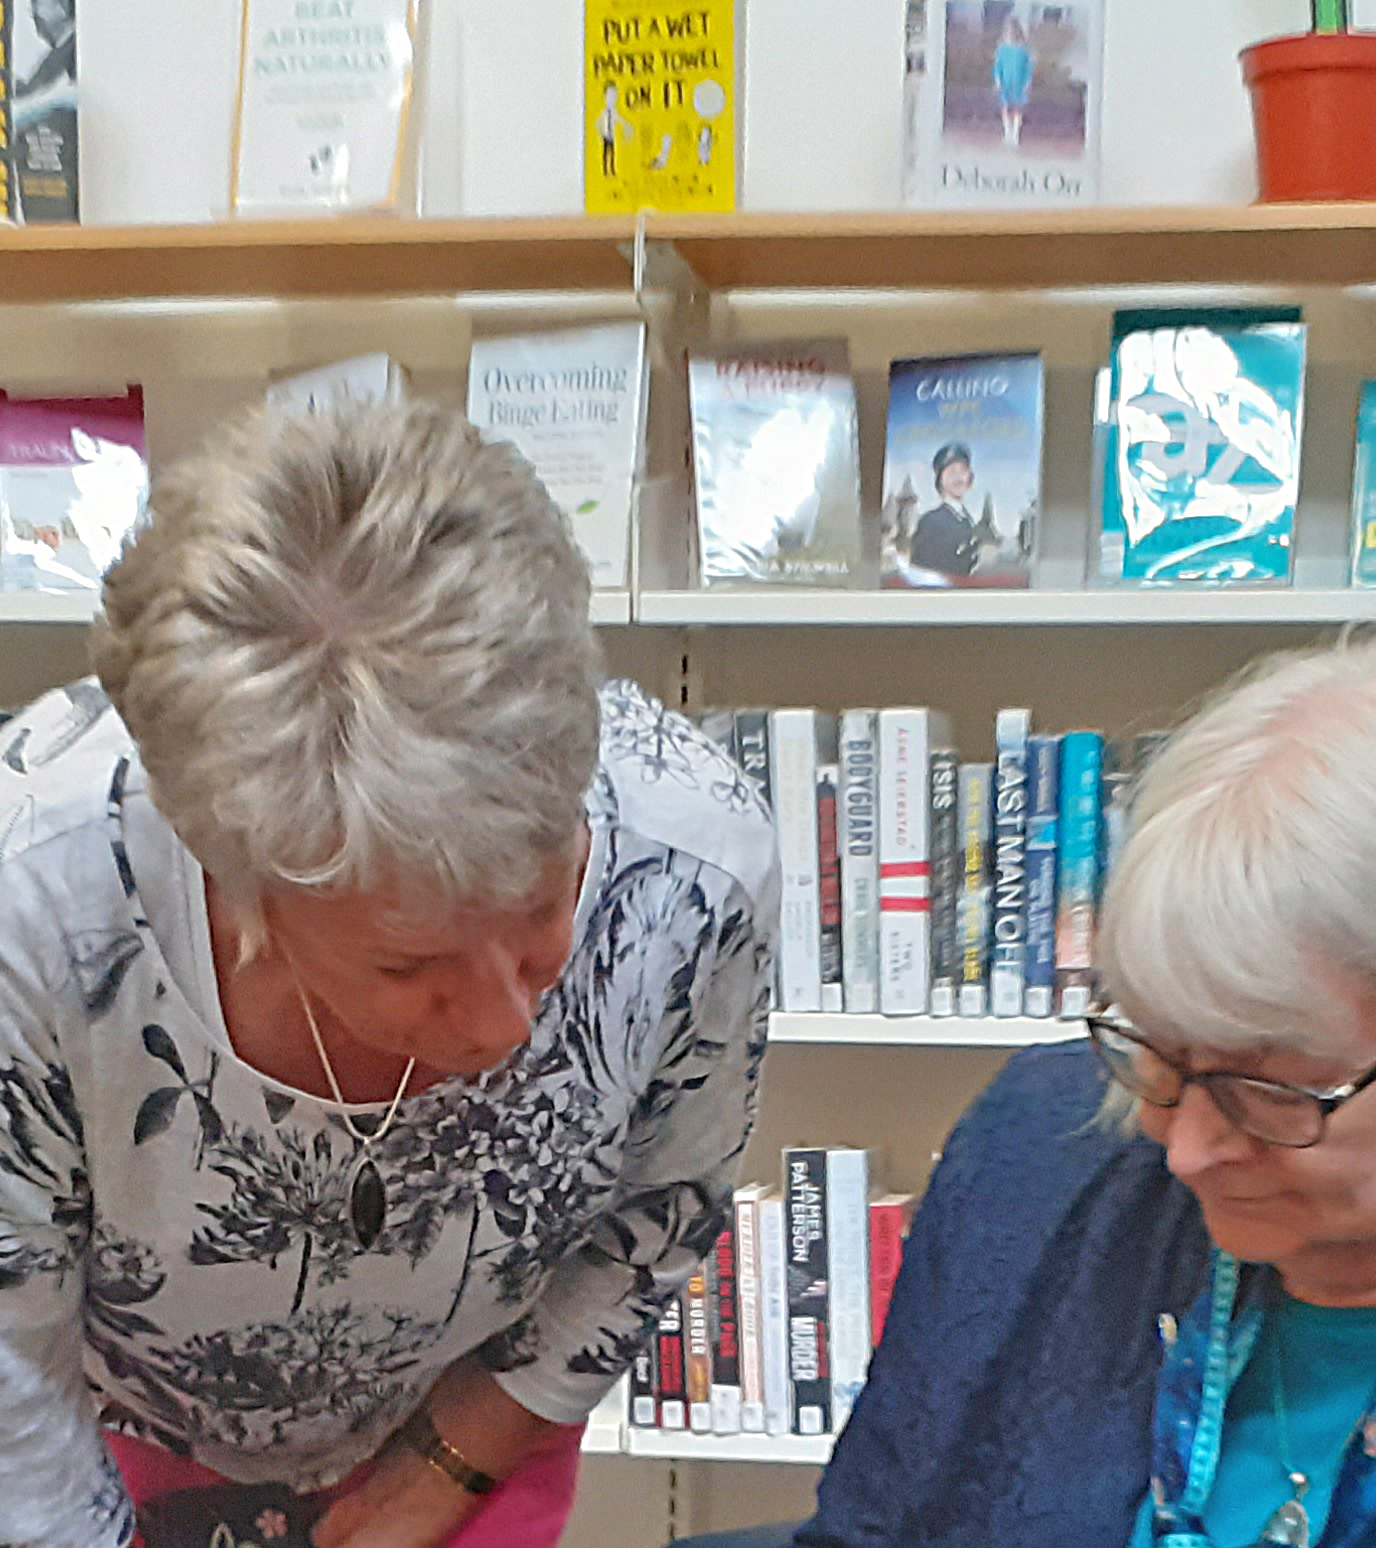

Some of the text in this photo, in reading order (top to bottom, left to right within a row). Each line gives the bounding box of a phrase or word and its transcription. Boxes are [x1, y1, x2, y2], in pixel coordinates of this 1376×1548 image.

[603, 11, 710, 45] PUT A WET
[593, 48, 720, 78] PAPER TOWEL
[625, 80, 684, 110] ON IT
[483, 362, 628, 396] Overcoming
[915, 375, 1010, 402] CALLING
[489, 400, 619, 428] Binge Eating
[844, 740, 875, 857] BODYGUARD
[931, 759, 955, 811] ISIS
[997, 750, 1025, 829] LAST
[996, 833, 1025, 909] MAN
[790, 1161, 809, 1263] PATTERSON
[804, 1183, 823, 1242] JAMES
[689, 1298, 706, 1355] MURDER
[790, 1316, 819, 1381] MURDER
